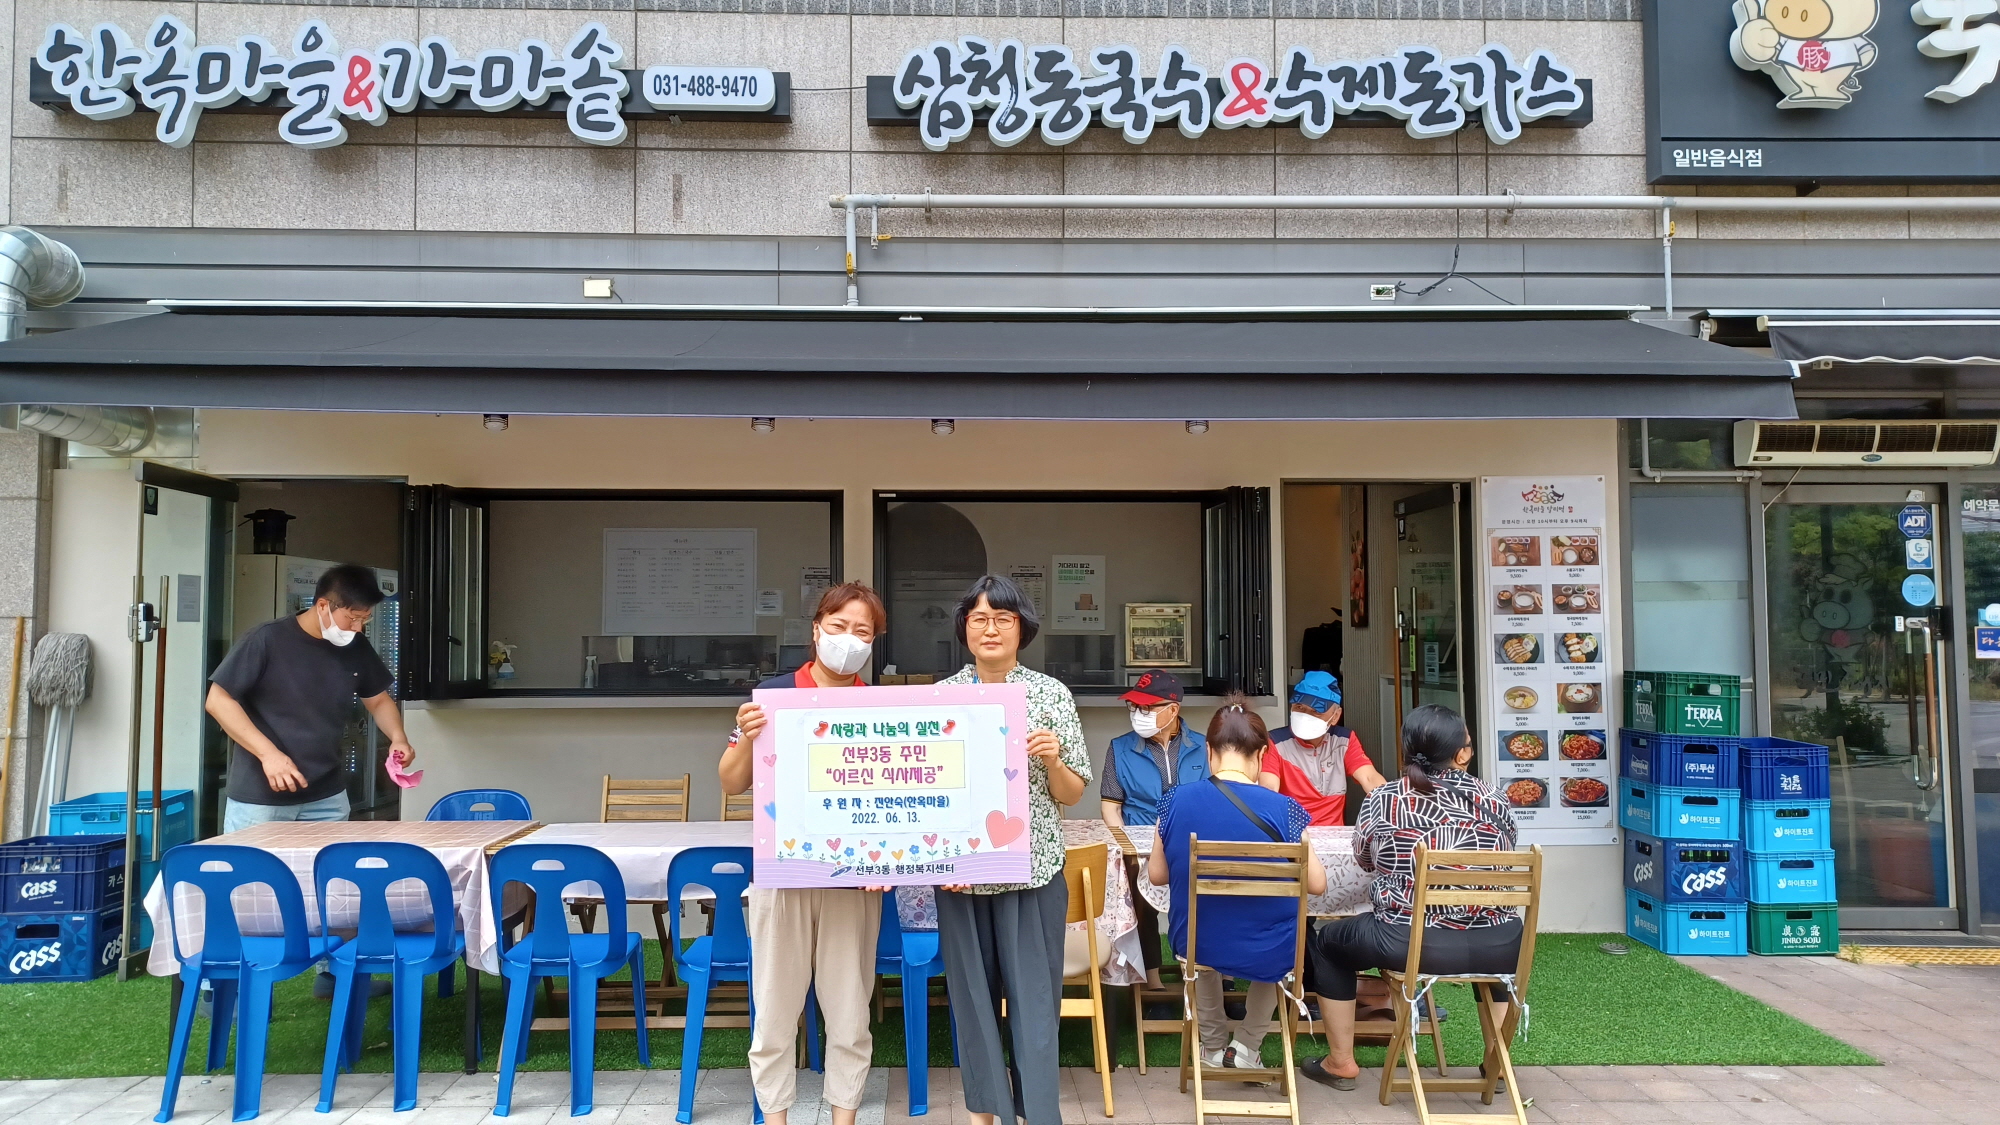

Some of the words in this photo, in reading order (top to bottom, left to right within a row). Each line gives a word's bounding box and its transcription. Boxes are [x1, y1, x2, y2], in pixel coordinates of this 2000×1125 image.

[46, 22, 622, 136] 한옥마을&가마솥
[651, 73, 758, 99] 031-488-9470
[1672, 148, 1763, 168] 일반음식점
[1904, 516, 1927, 528] ADT
[1635, 701, 1654, 717] TERRA
[1684, 704, 1723, 721] TERRA
[831, 722, 867, 738] 사랑과
[873, 721, 910, 737] 나눔의
[915, 720, 941, 737] 실천
[842, 745, 892, 764] 선부3동
[900, 745, 927, 763] 주민
[822, 797, 832, 810] 후
[837, 797, 847, 810] 원
[851, 797, 862, 810] 자
[851, 812, 880, 824] 2022.
[885, 811, 901, 824] 06.
[907, 811, 921, 823] 13.
[1689, 815, 1721, 824] 하이트진로
[1784, 828, 1814, 836] 하이트진로
[855, 862, 891, 876] 선부3동
[895, 862, 955, 875] 행정복지센터
[1787, 879, 1818, 888] 하이트진로
[1699, 930, 1731, 938] 하이트진로
[1781, 936, 1802, 945] JINRO
[1803, 936, 1821, 944] SOJU
[102, 933, 123, 966] Cas
